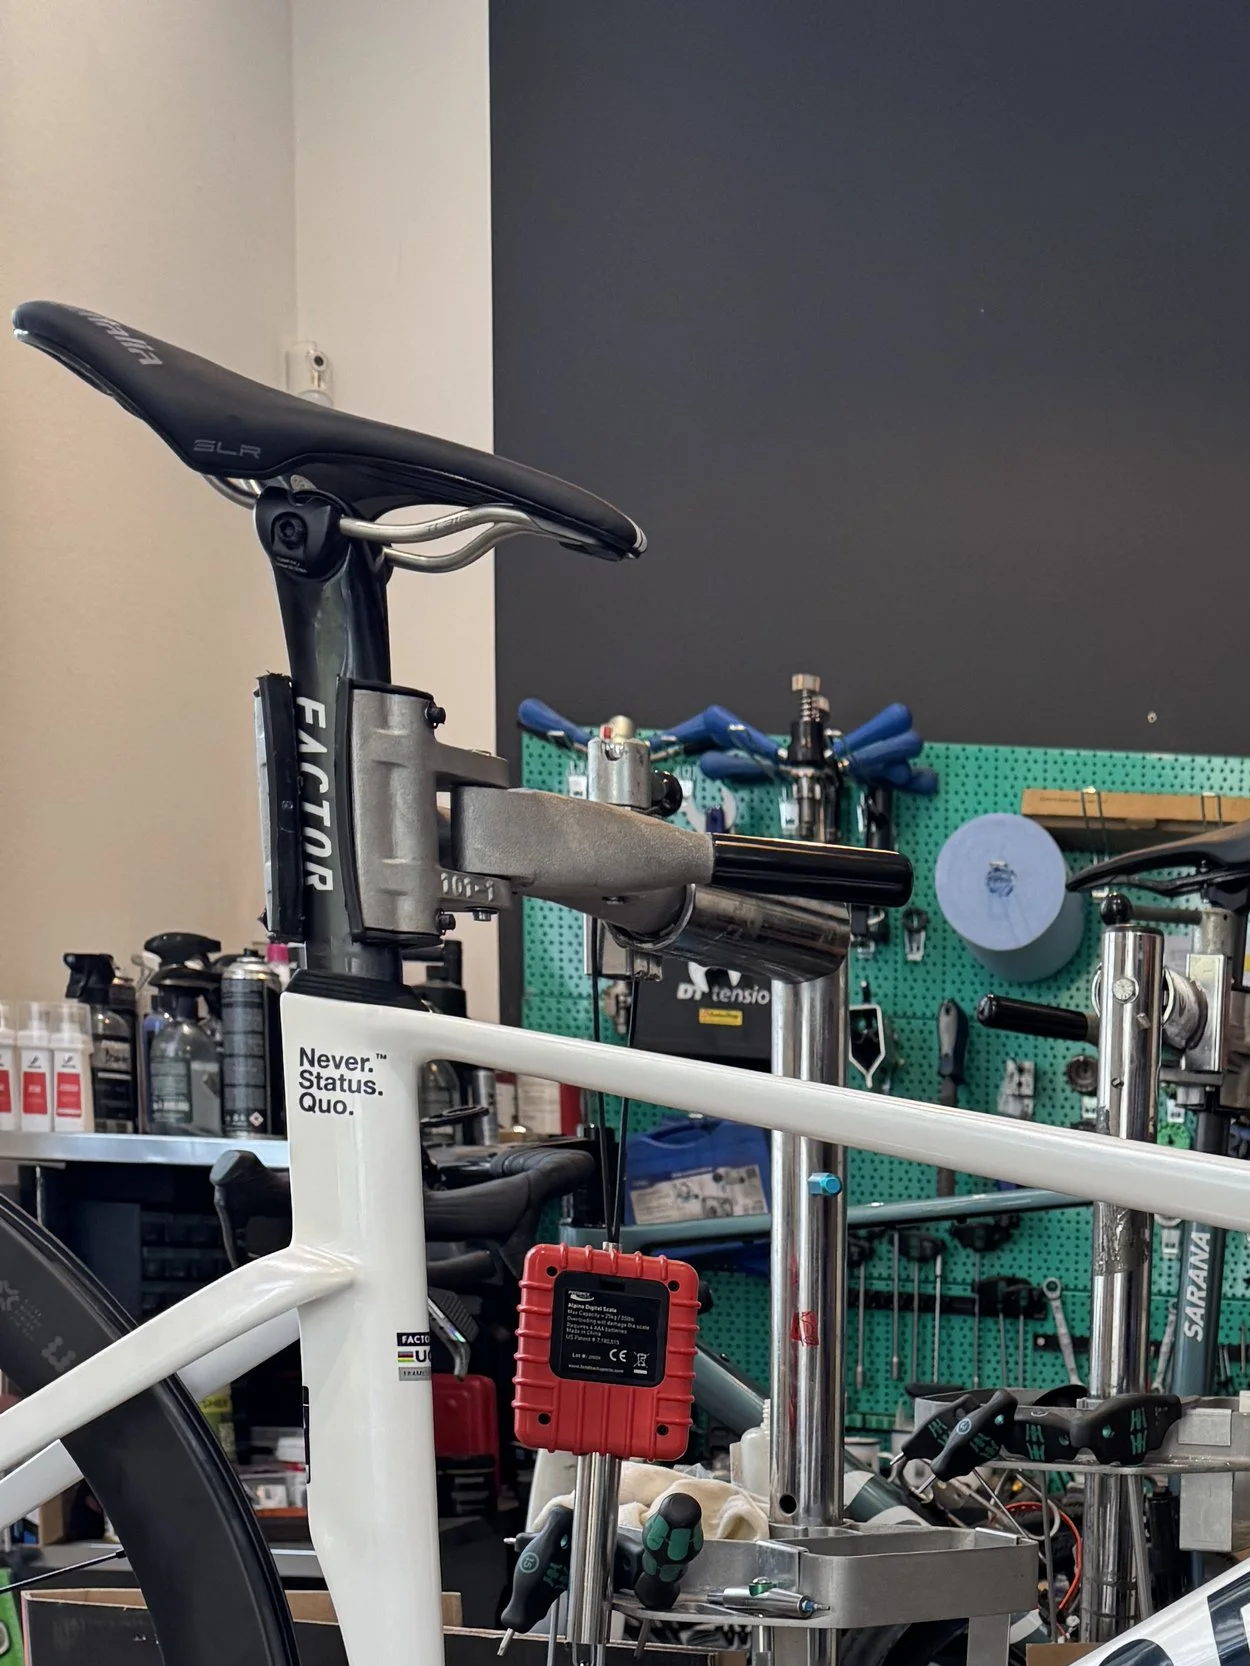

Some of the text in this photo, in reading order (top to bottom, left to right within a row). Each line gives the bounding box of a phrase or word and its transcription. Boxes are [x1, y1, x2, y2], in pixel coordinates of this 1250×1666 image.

[193, 439, 261, 459] SLR
[296, 696, 334, 892] FACTOR
[299, 1069, 383, 1096] Status.
[299, 1091, 354, 1116] Quo.
[1183, 1232, 1211, 1343] SARANA
[402, 1335, 430, 1344] FACTO
[609, 1348, 628, 1362] CE
